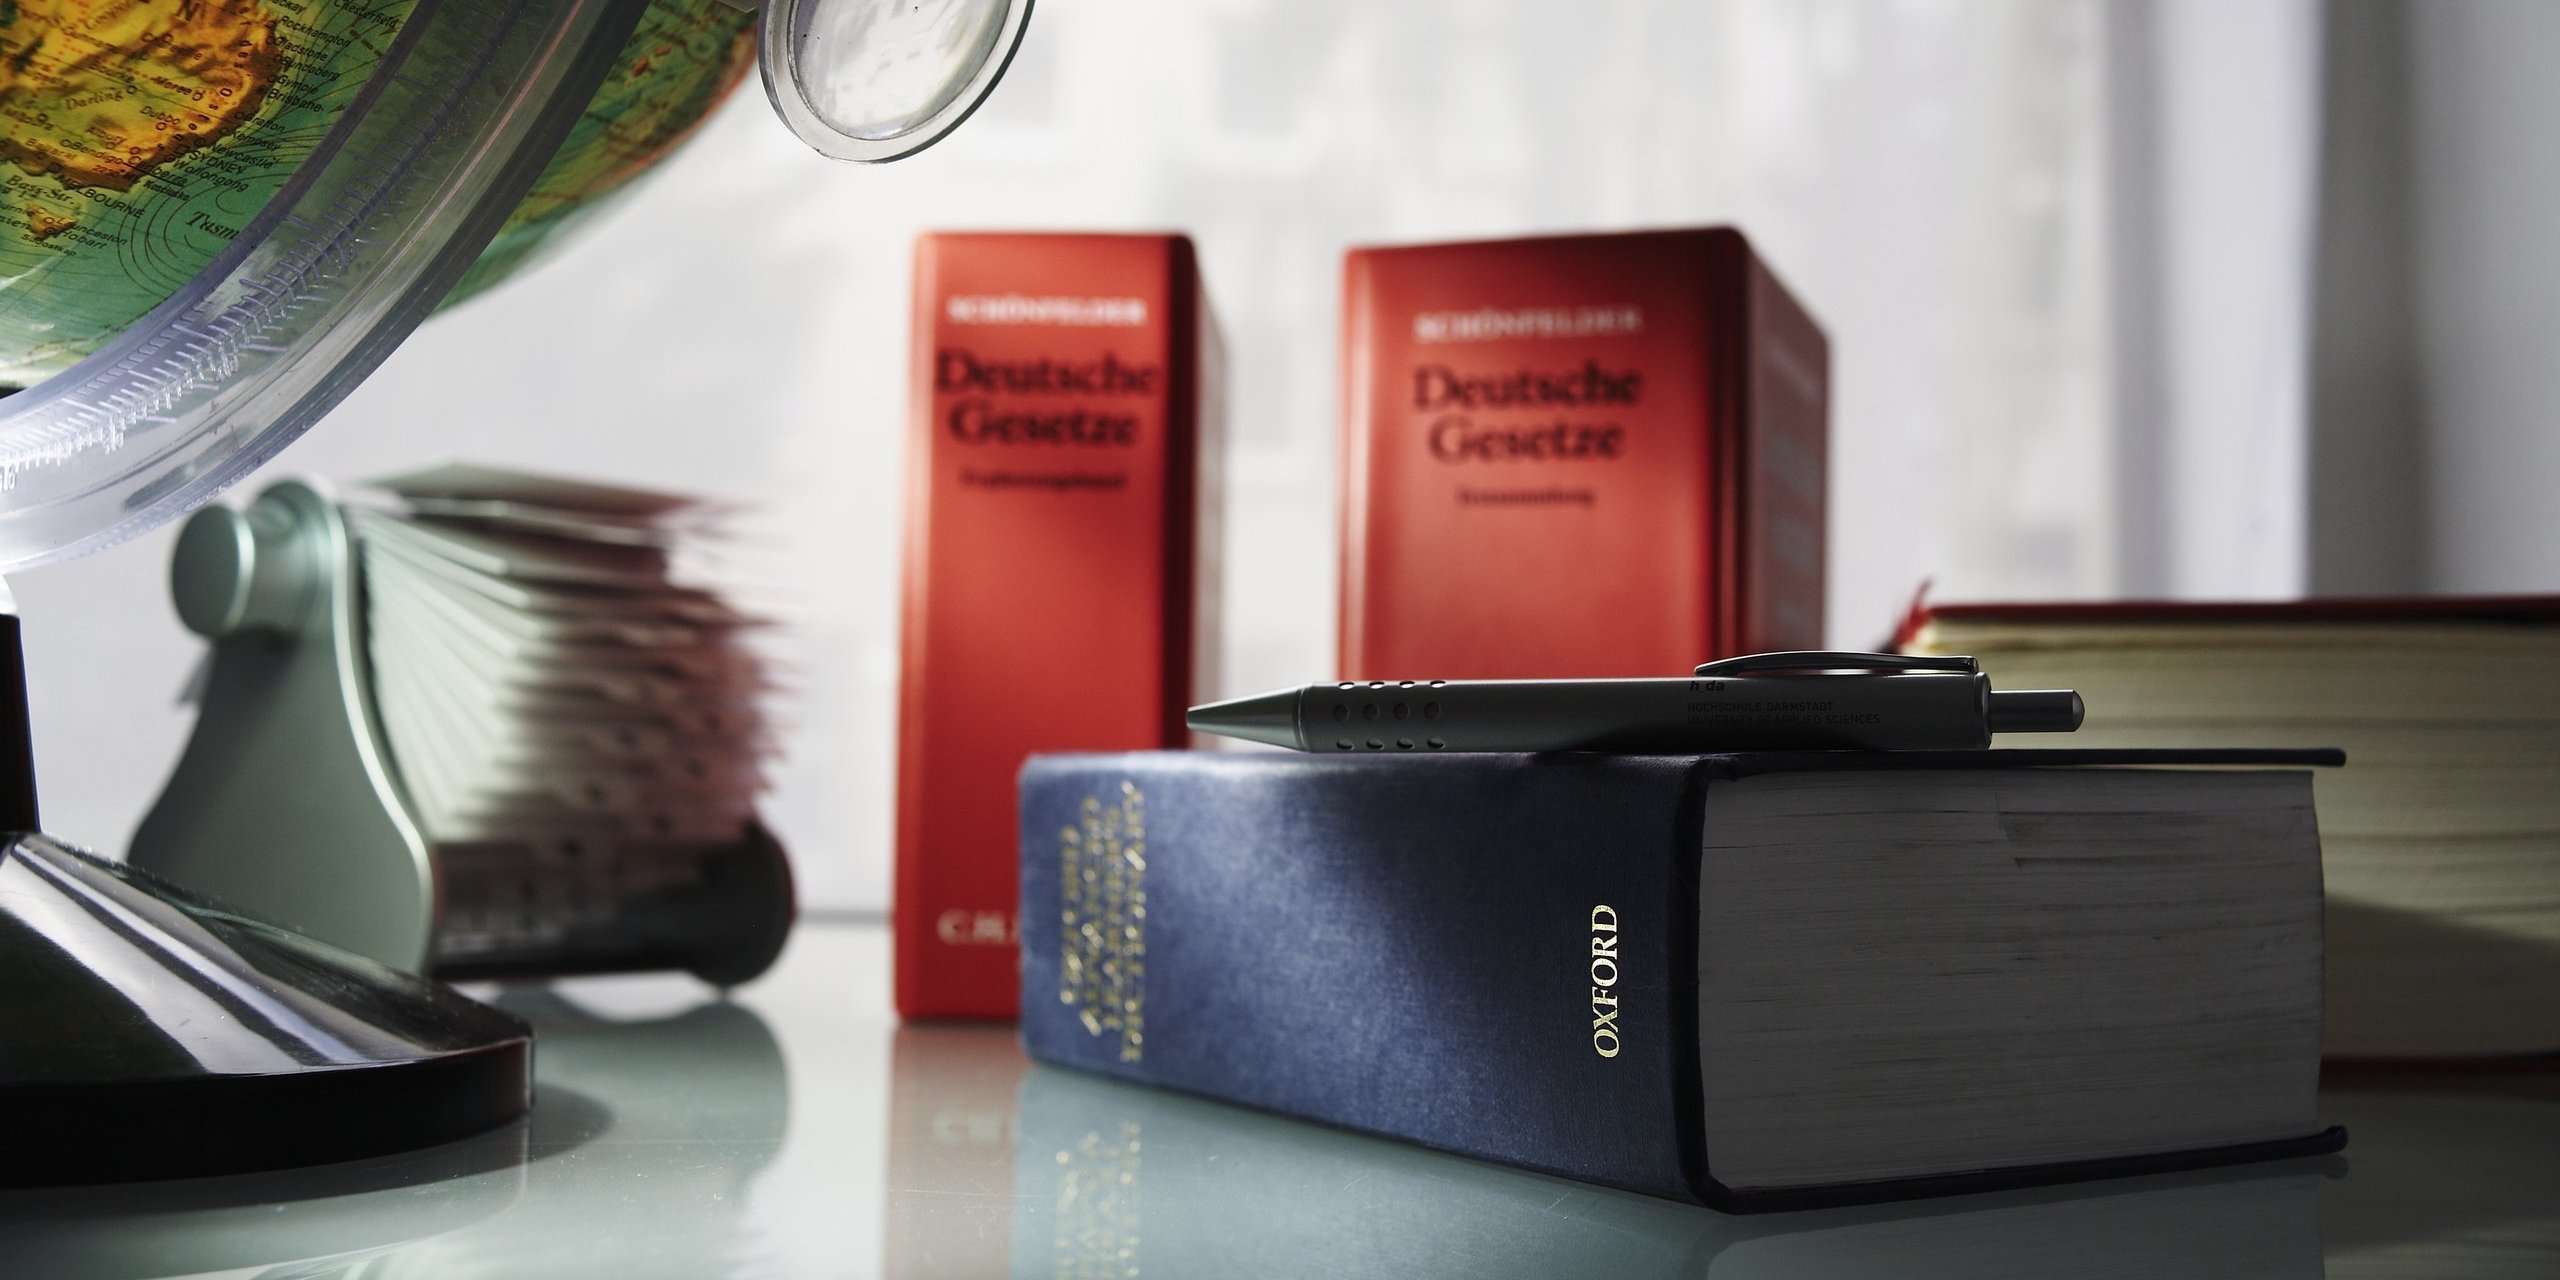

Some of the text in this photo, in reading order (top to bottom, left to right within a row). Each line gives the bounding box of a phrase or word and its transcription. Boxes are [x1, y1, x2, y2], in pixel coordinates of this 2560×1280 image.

[280, 15, 352, 48] Rockhampton
[275, 35, 329, 61] Gladstone
[280, 56, 341, 82] Bundaberg
[277, 75, 320, 95] Gympie
[267, 88, 323, 113] Brisbane
[140, 105, 182, 126] Dubbo
[69, 140, 125, 164] Bendigo
[232, 131, 282, 151] Kempsey
[189, 149, 249, 176] SYDNEY
[211, 143, 275, 170] Newcastle
[128, 155, 190, 188] Canberra
[172, 158, 250, 193] Wollongong
[56, 172, 146, 219] MELBOURNE
[57, 214, 129, 246] Launceston
[61, 228, 109, 251] Hobart
[1413, 305, 1643, 343] SCHÖNFELDER
[936, 346, 1161, 394] Deutsche
[1415, 358, 1644, 410] Deutsche
[948, 397, 1140, 444] Gesetze
[1428, 414, 1625, 464] Gesetze
[1688, 700, 1833, 713] HOCHSCHULE DARMSTADT
[1774, 714, 1821, 726] APPLIED
[1824, 713, 1881, 725] SCIENCES
[1591, 904, 1620, 1059] OXFORD
